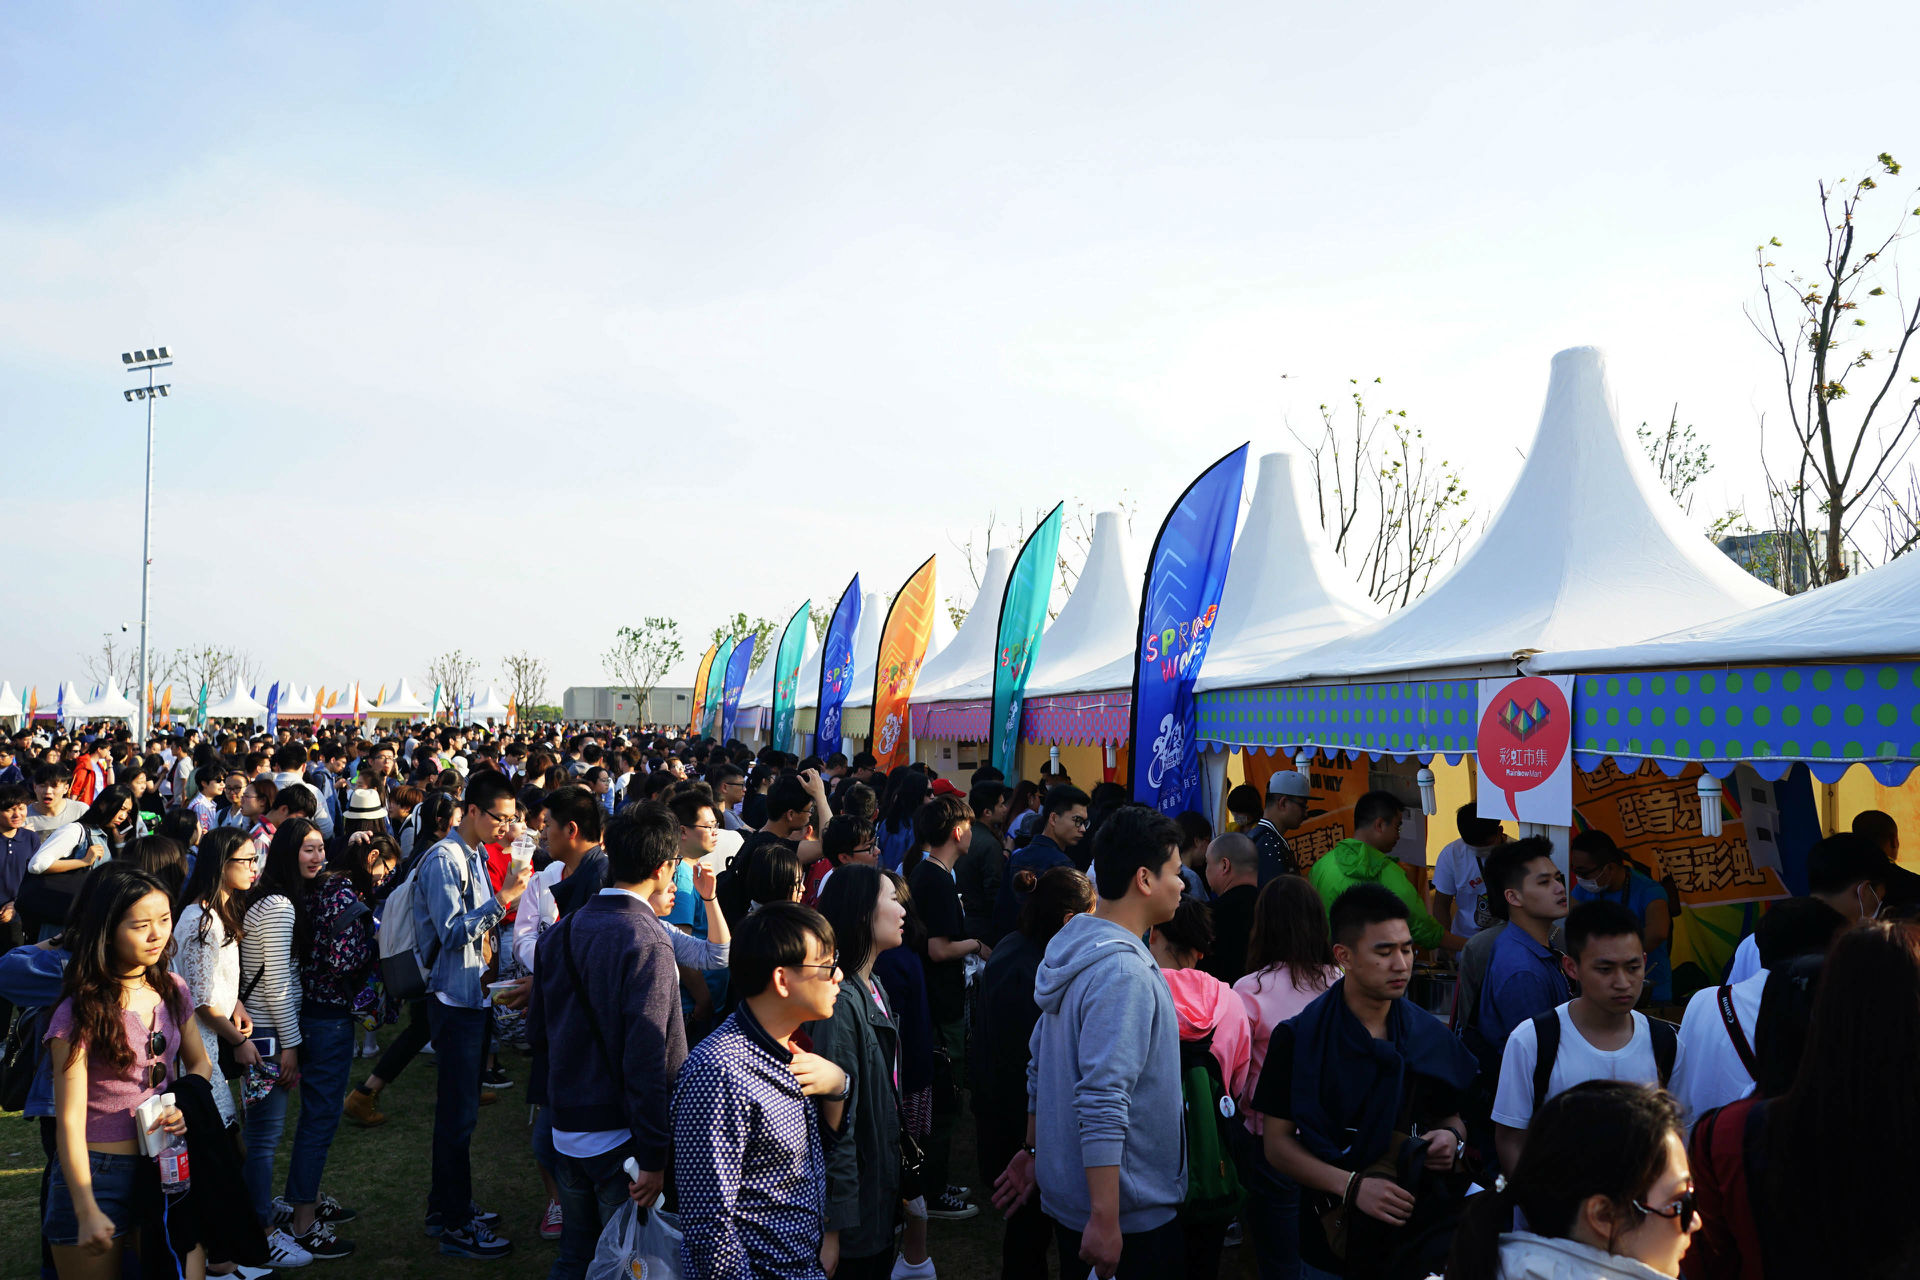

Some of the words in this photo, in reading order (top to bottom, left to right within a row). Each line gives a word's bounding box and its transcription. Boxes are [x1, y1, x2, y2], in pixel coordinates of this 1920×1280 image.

[1499, 747, 1549, 766] 彩虹市集
[1722, 996, 1735, 1024] Canon
